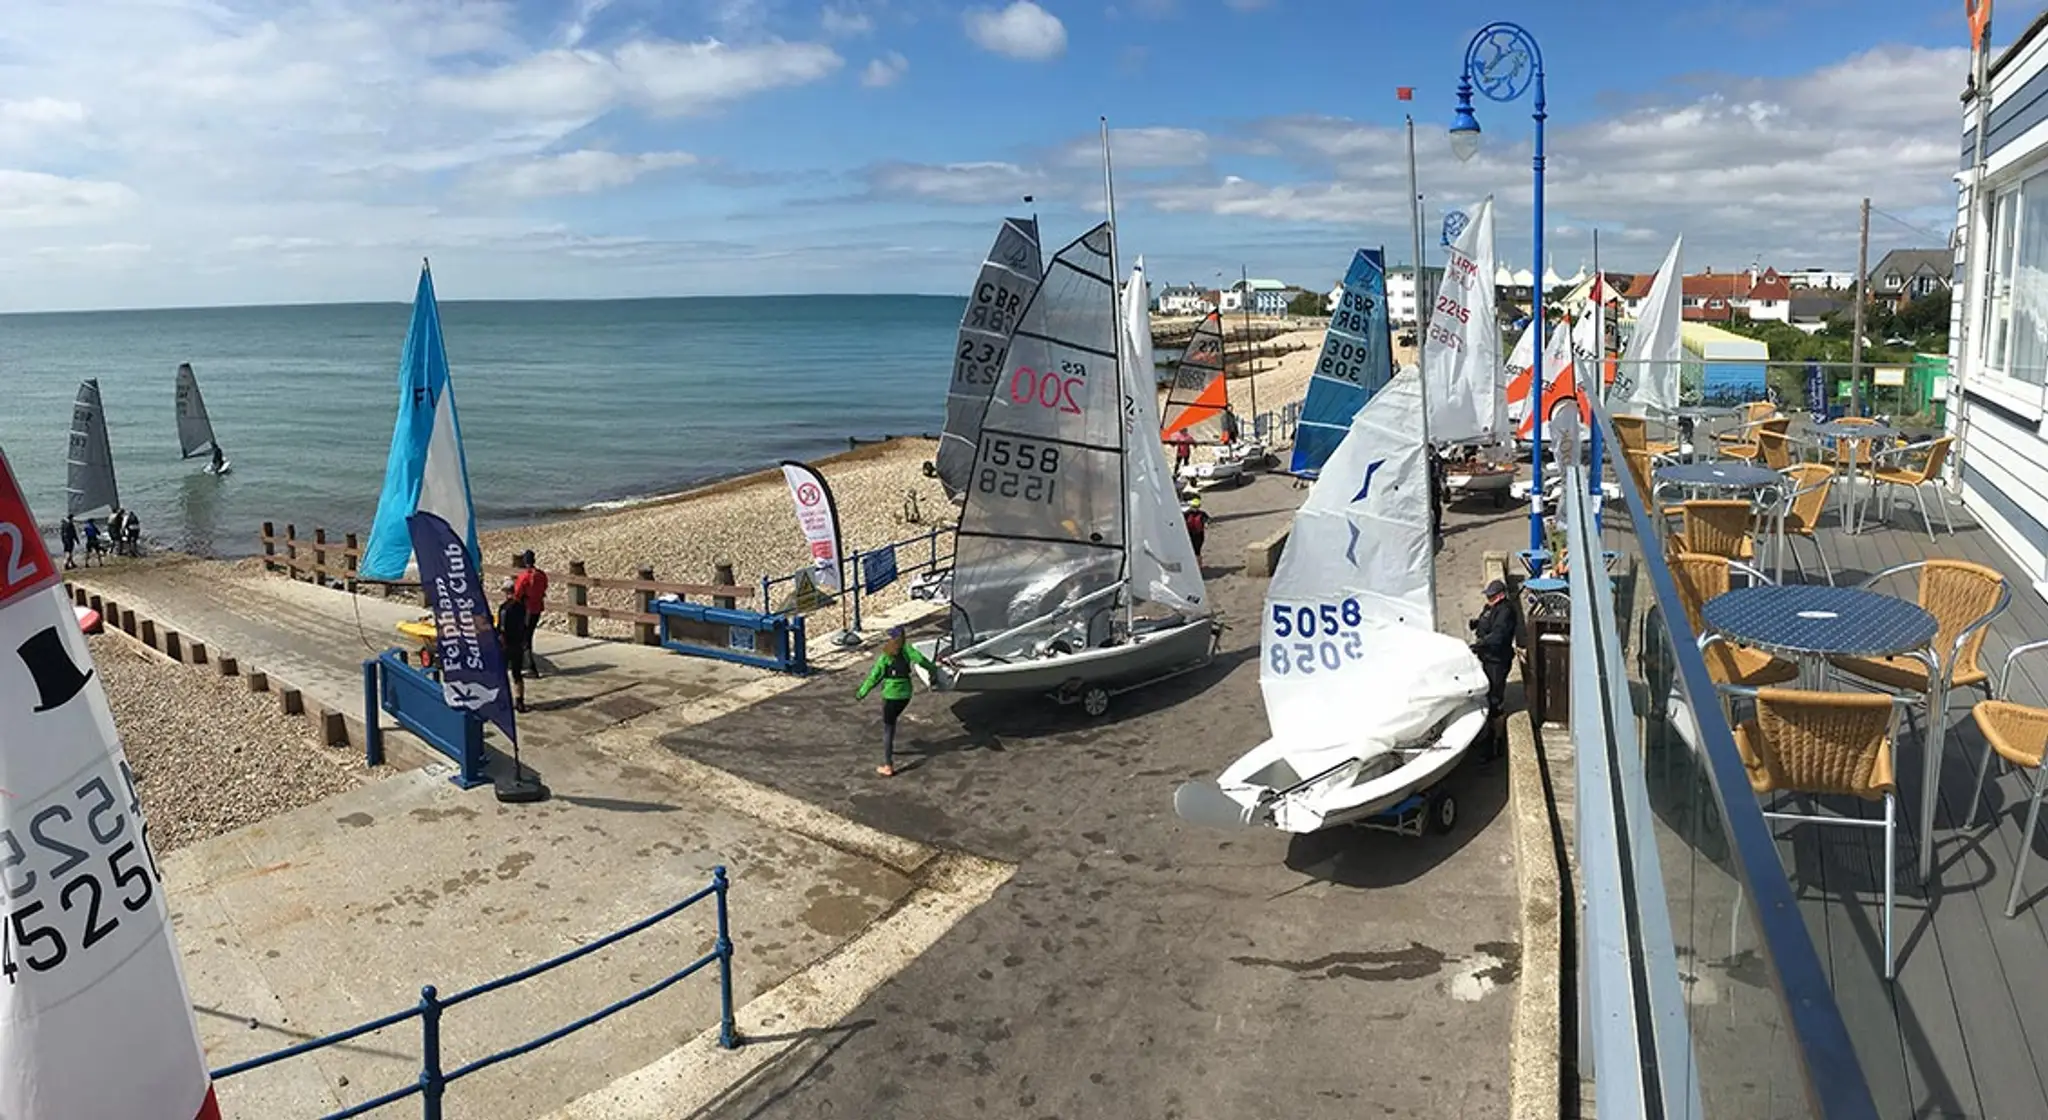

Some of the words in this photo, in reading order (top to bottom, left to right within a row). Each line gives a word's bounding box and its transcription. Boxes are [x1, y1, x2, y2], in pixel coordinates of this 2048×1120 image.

[979, 284, 1020, 315] GBR
[1343, 291, 1375, 317] GBR
[961, 340, 1005, 366] 231
[1327, 340, 1366, 364] 309
[982, 438, 1060, 474] 1558
[0, 522, 37, 586] 2
[444, 542, 468, 594] Club
[435, 577, 462, 671] Felpham
[457, 598, 484, 670] Sailing
[1273, 598, 1362, 638] 5058
